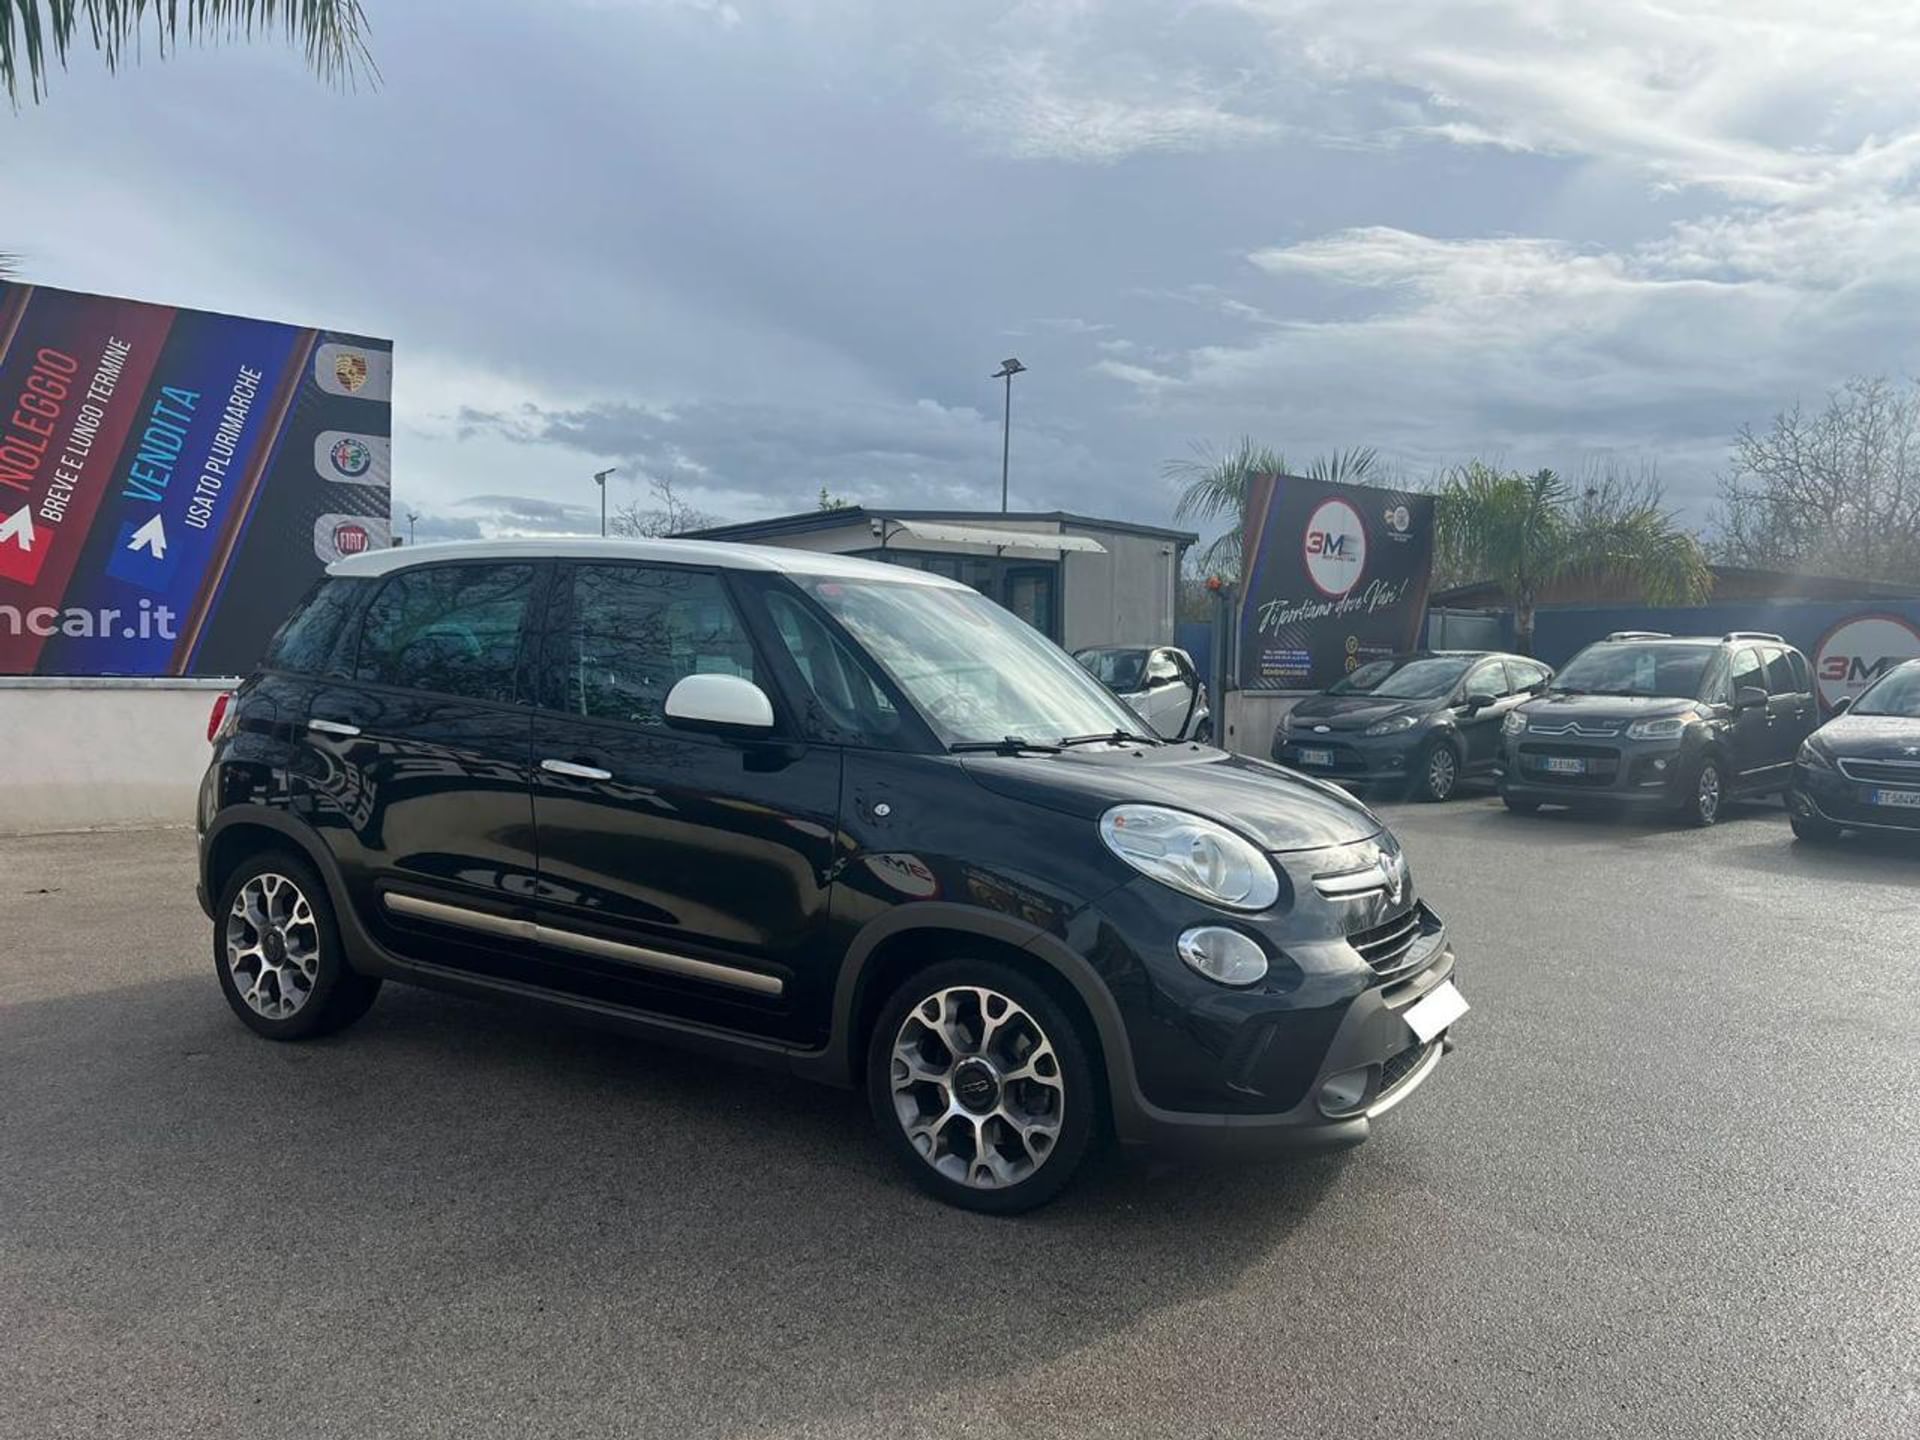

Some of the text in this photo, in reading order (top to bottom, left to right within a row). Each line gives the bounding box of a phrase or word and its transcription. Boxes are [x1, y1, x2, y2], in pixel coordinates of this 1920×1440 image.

[0, 348, 78, 491] NOLEGGIO
[40, 336, 132, 522] BREVE E LUNGO TERMINE
[122, 385, 201, 502] VENDITA
[184, 364, 263, 529] USATO PLURIMARCHE
[340, 532, 365, 550] FIAT
